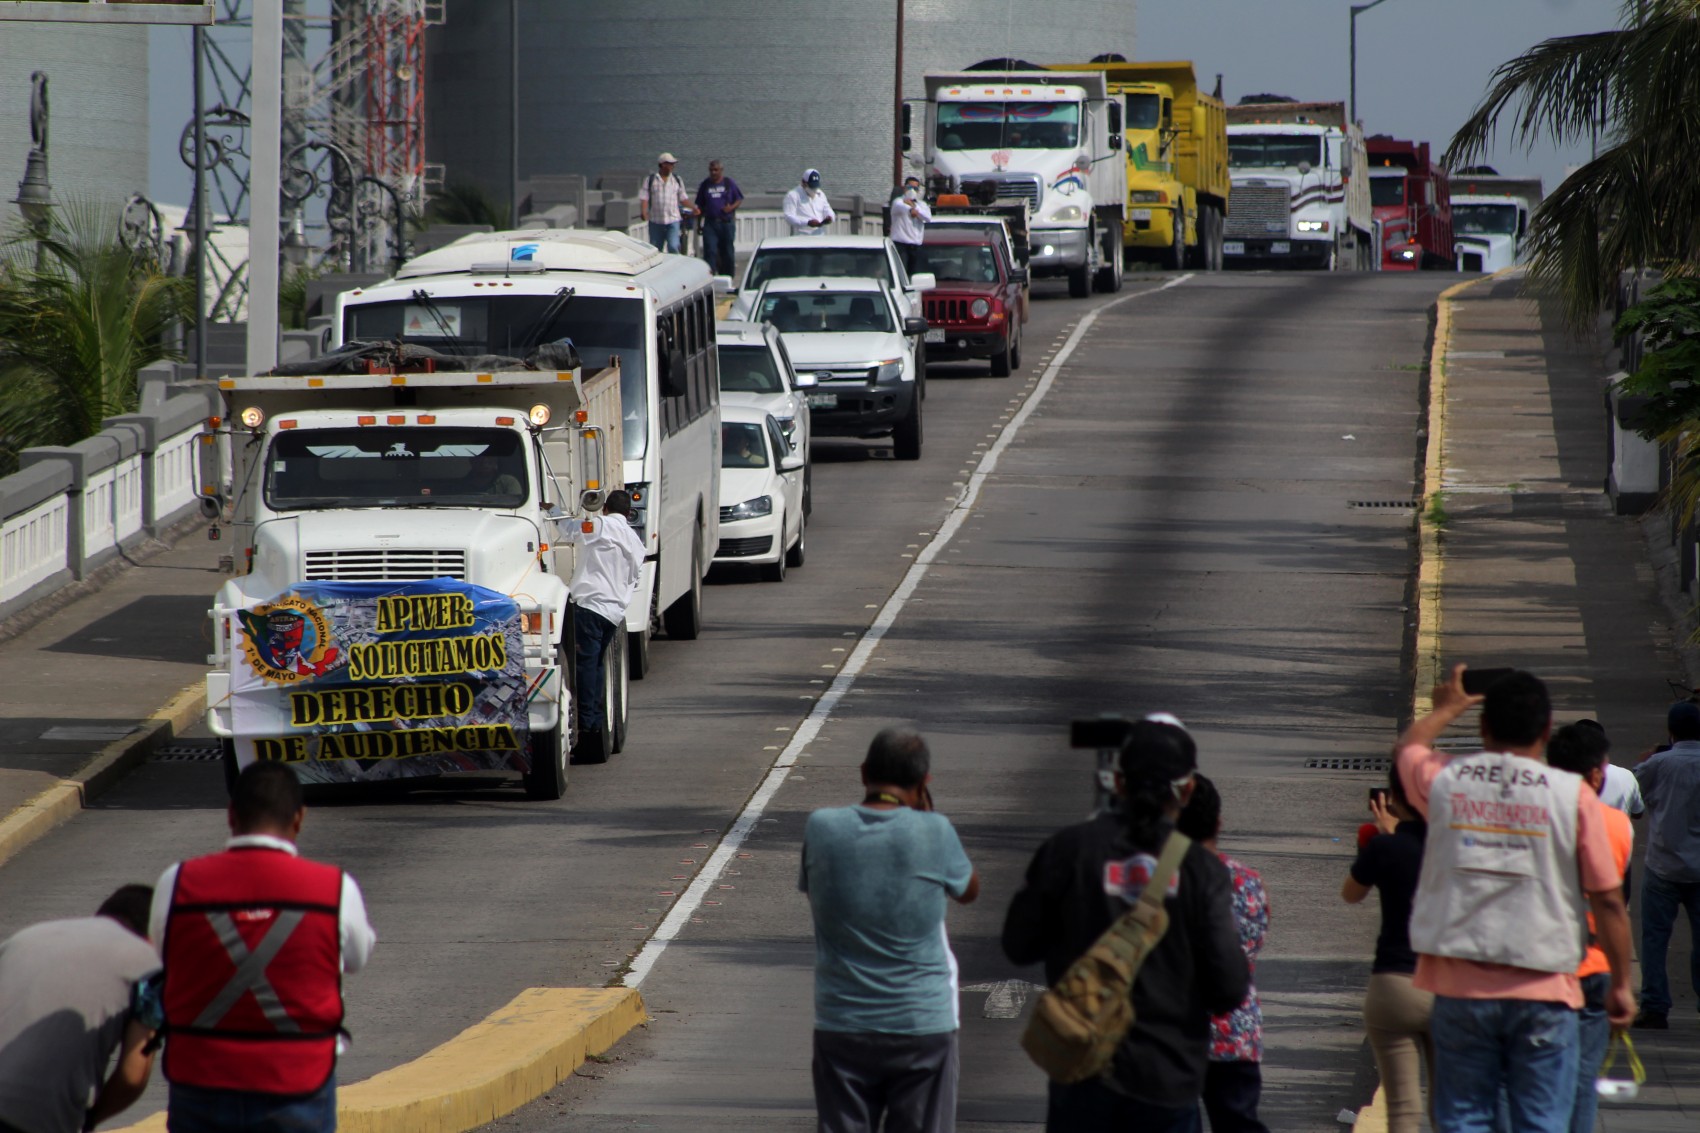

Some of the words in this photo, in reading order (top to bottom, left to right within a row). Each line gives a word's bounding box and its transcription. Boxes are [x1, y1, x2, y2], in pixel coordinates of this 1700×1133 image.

[306, 607, 327, 648] NACIONAL
[377, 594, 475, 632] APIVER:
[252, 659, 265, 673] DE
[265, 669, 296, 681] MAYO
[350, 635, 505, 680] SOLICITAMOS
[291, 684, 473, 727] DERECHO
[253, 736, 309, 763] DE
[317, 725, 519, 760] AUDIENCIA
